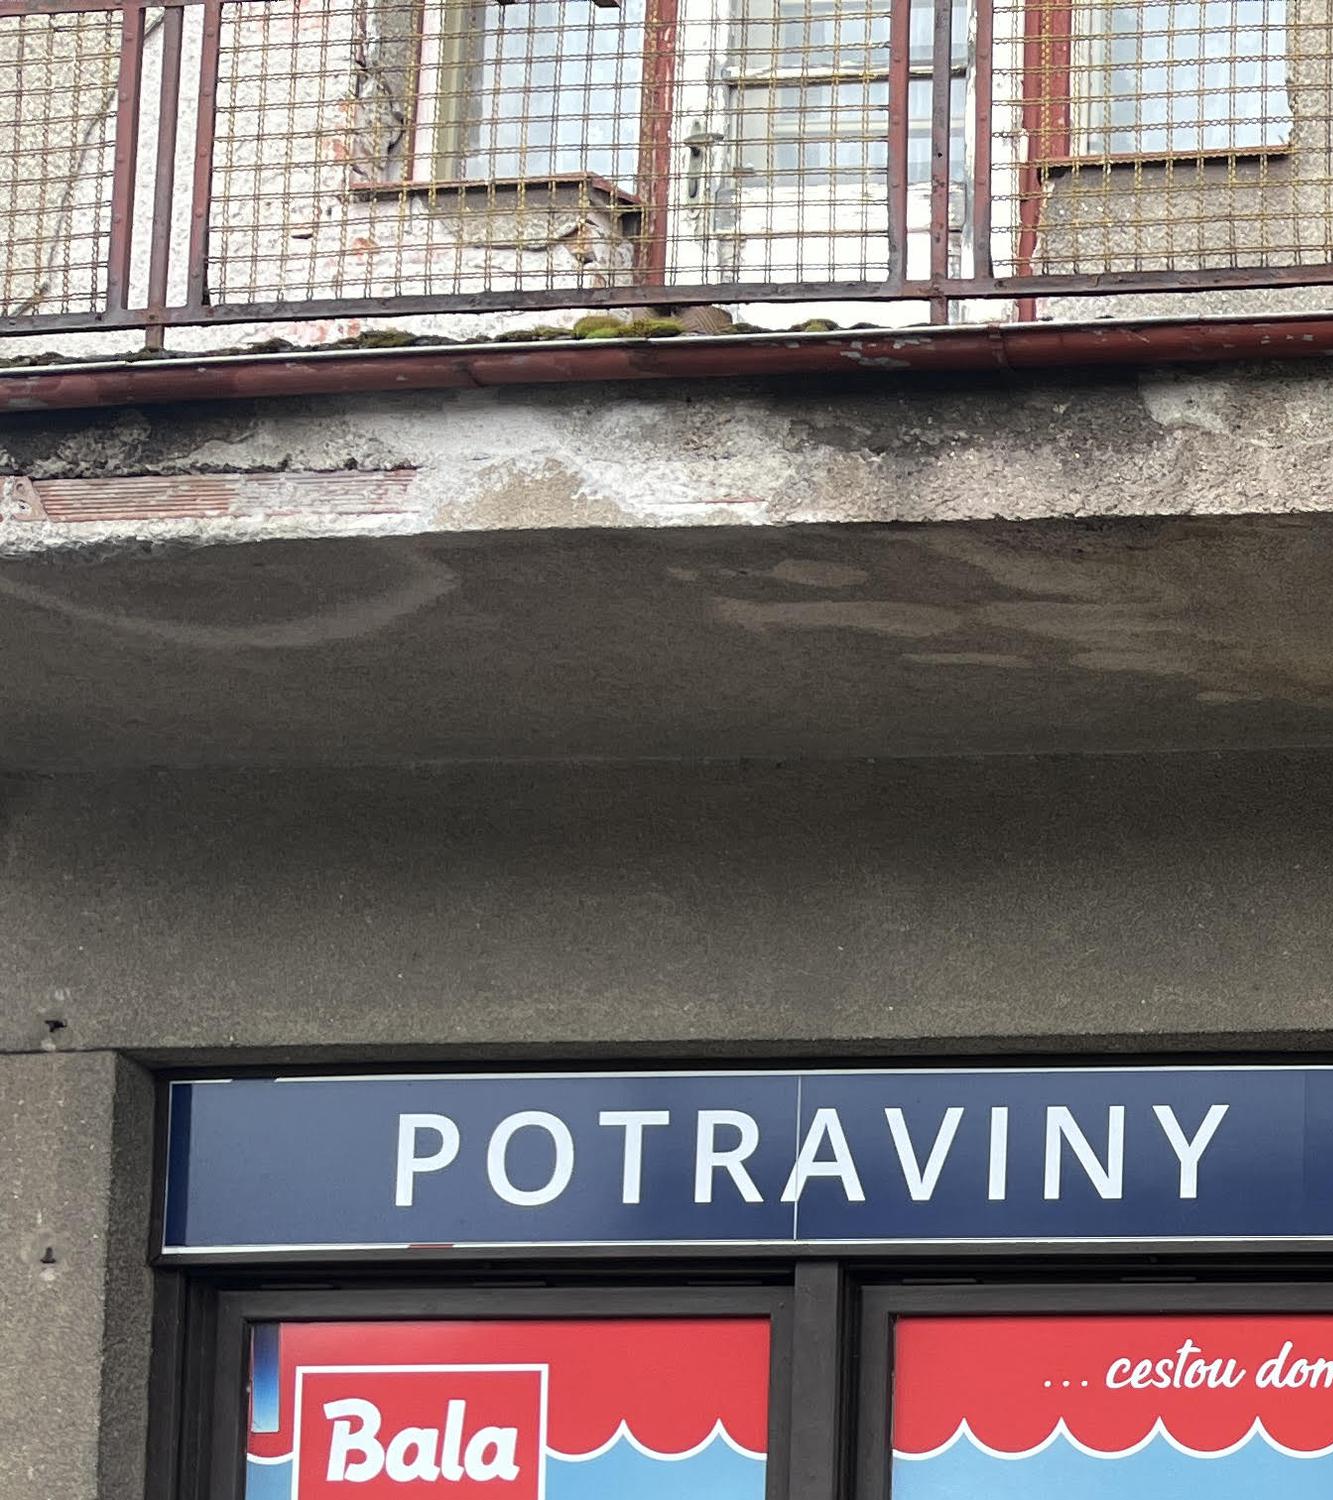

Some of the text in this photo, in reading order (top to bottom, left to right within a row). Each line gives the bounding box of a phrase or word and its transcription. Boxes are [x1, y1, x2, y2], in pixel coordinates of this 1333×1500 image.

[396, 1103, 1230, 1206] POTRAVINY
[1105, 1338, 1246, 1389] cestou
[324, 1398, 520, 1482] Bala
